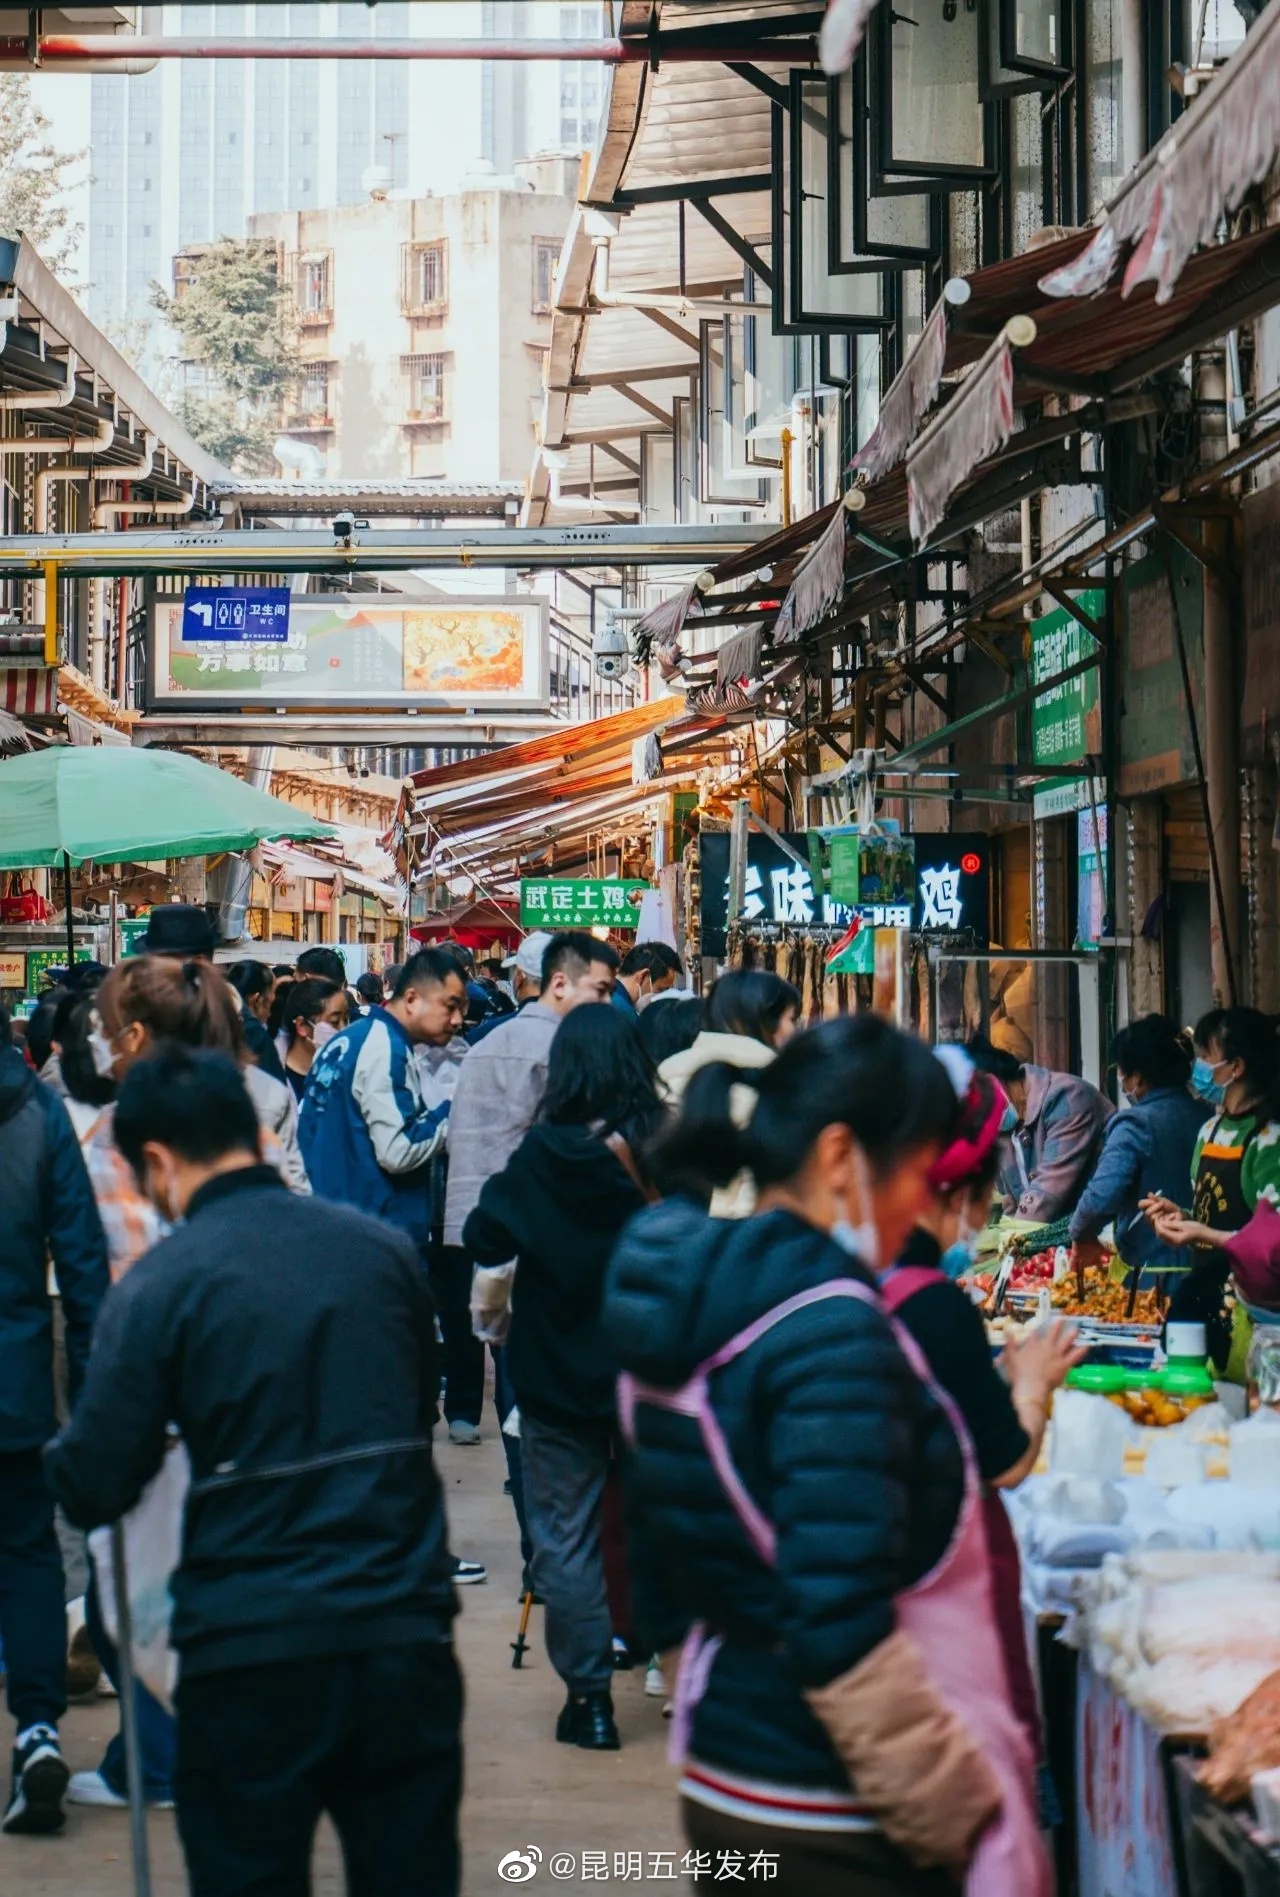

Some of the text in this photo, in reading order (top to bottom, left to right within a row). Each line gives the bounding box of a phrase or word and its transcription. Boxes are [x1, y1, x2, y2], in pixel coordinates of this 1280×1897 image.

[249, 604, 287, 616] 卫生间
[260, 617, 274, 625] WC
[197, 653, 308, 673] 万事如意
[526, 885, 625, 910] 武定土鸡
